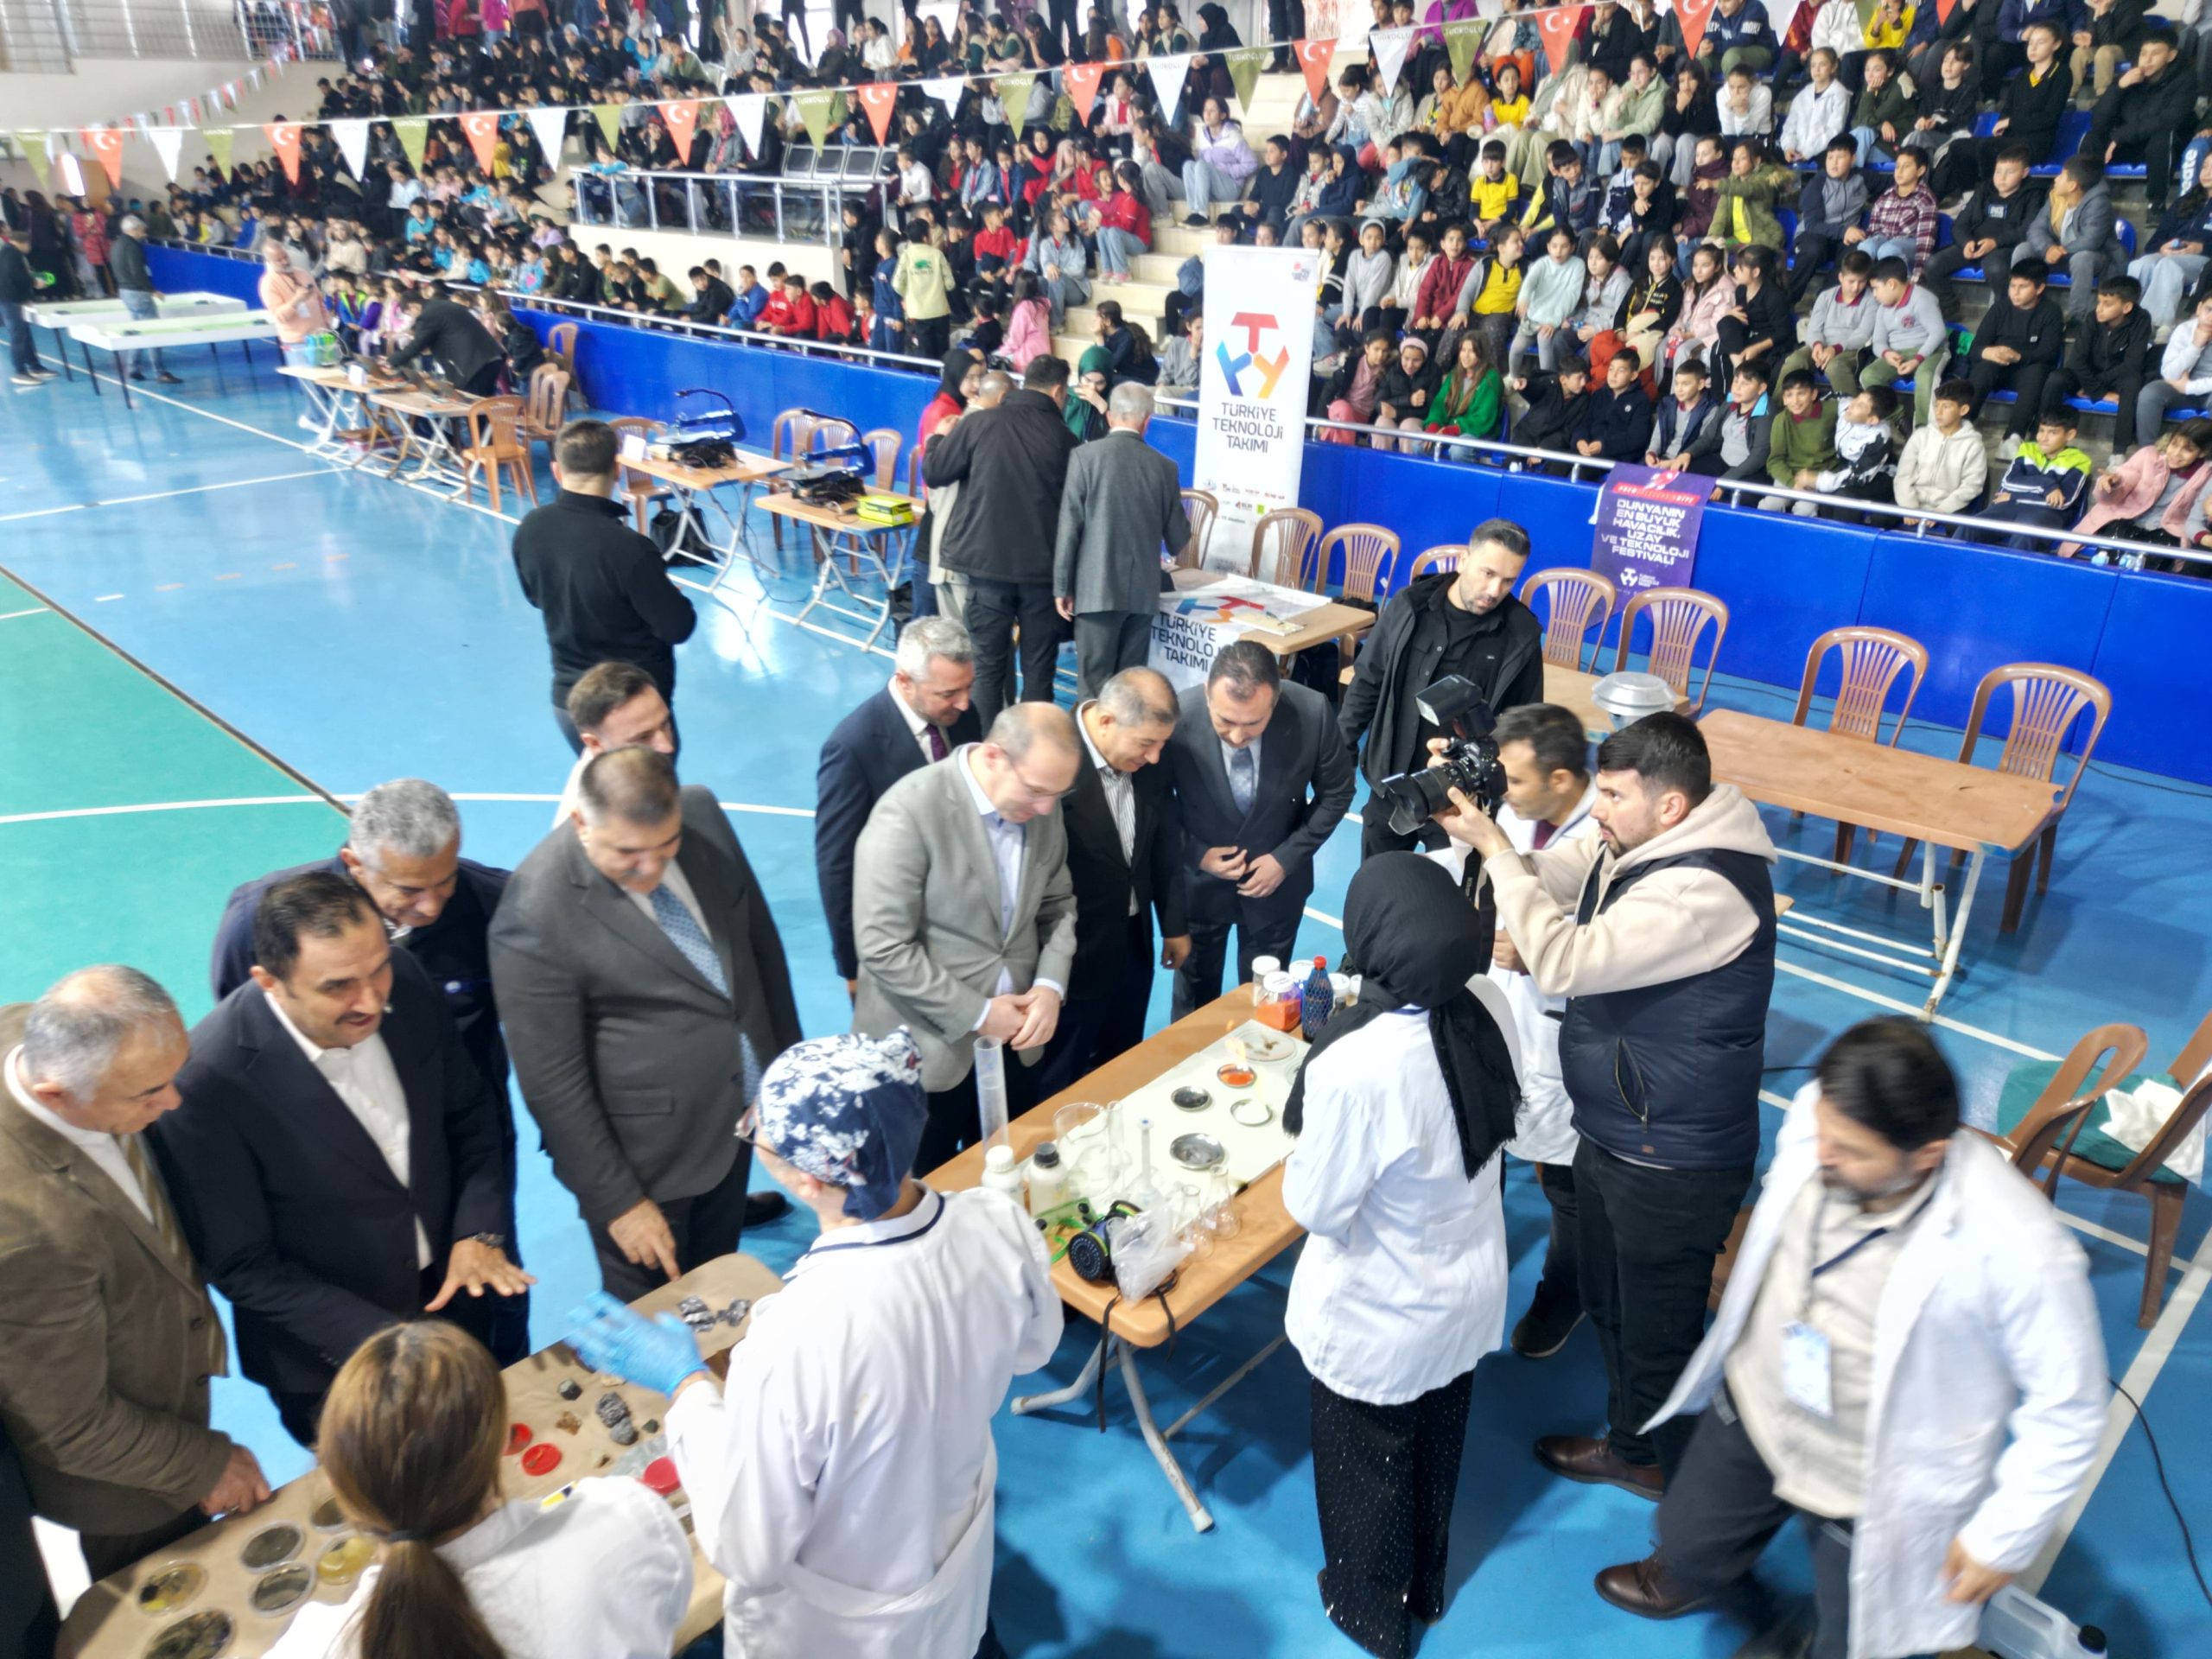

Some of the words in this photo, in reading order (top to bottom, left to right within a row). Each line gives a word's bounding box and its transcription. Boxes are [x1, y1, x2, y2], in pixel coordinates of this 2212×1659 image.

[1226, 435, 1268, 454] TAKIMI
[1616, 508, 1634, 519] EN
[1601, 533, 1618, 544] VE
[1627, 529, 1662, 543] UZAY
[1164, 645, 1209, 672] TAKIMI
